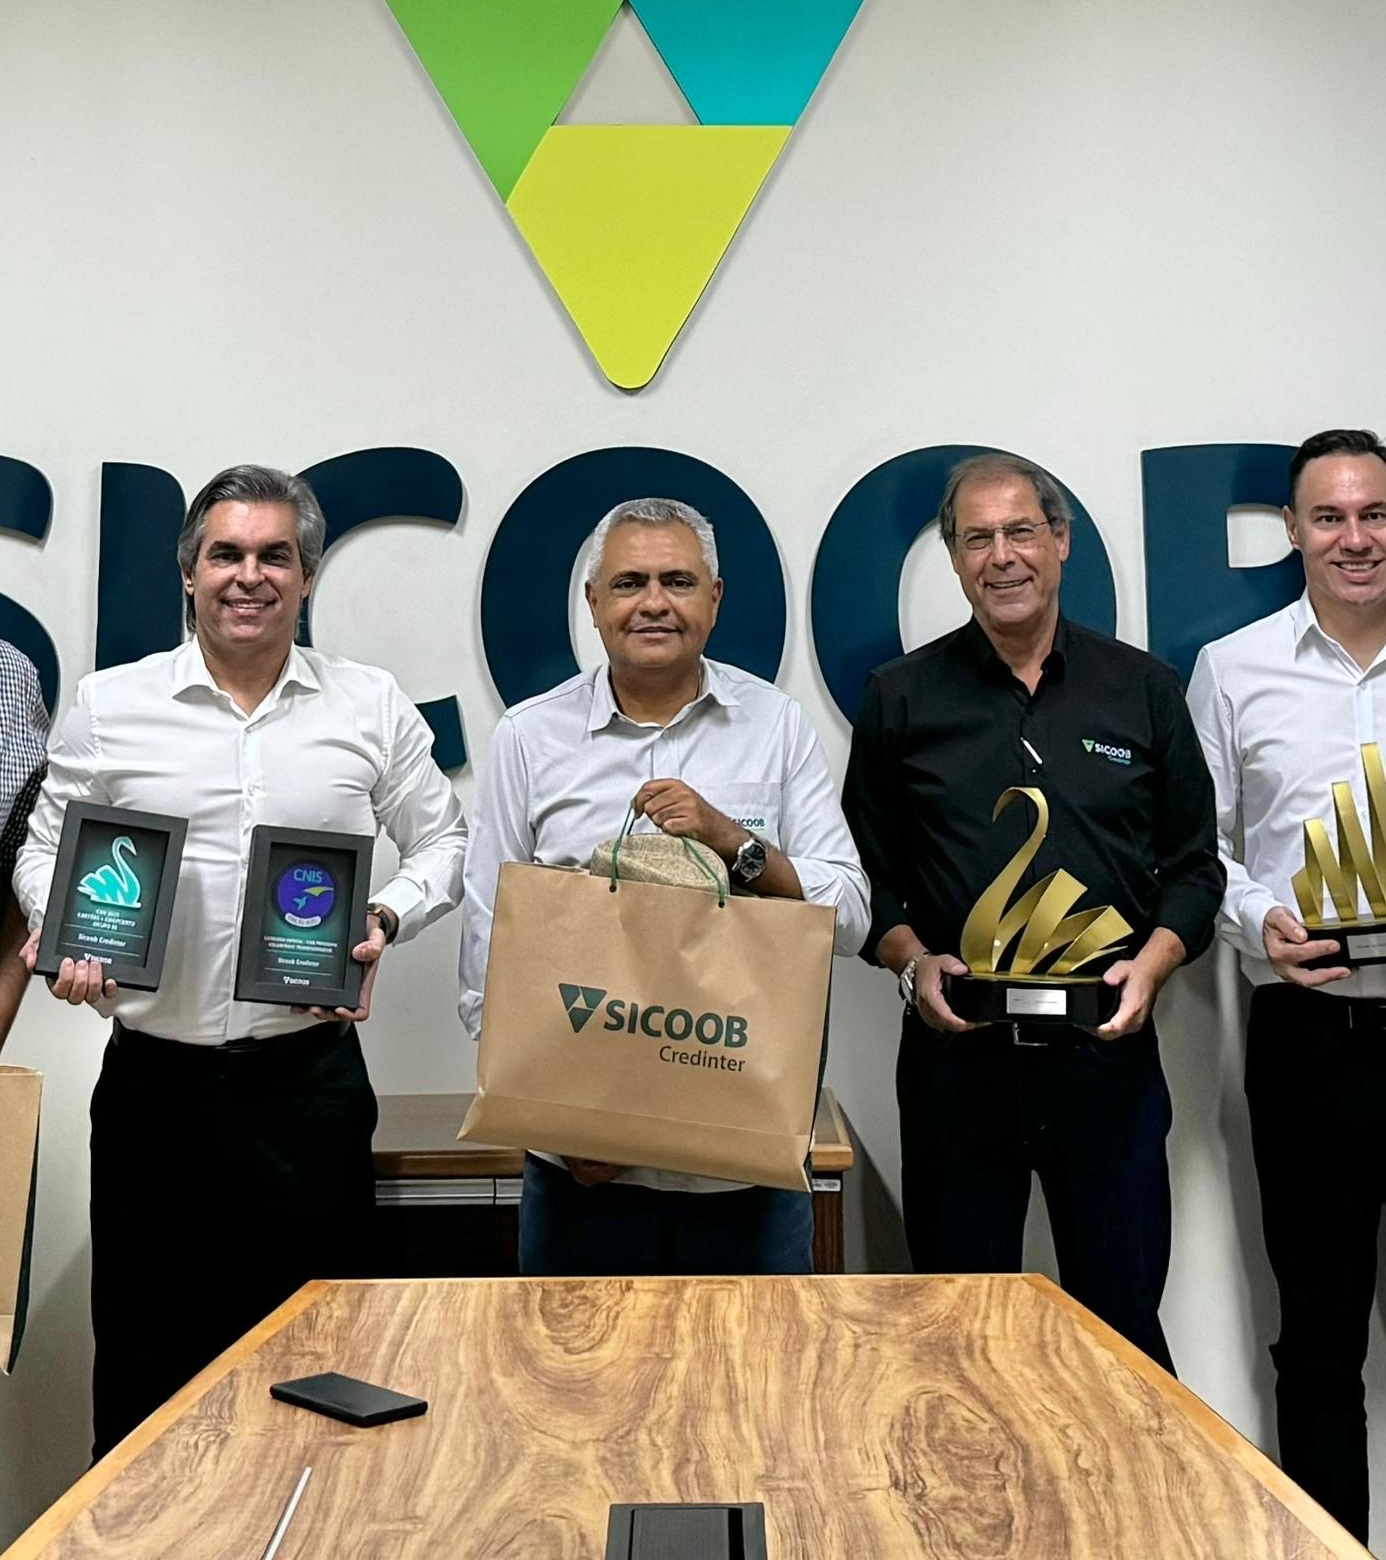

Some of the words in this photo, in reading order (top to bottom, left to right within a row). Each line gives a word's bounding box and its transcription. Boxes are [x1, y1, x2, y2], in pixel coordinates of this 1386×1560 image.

[1094, 743, 1132, 759] SICOOB
[293, 868, 323, 883] CNIS
[603, 999, 748, 1048] SICOOB
[659, 1045, 745, 1072] Credinter
